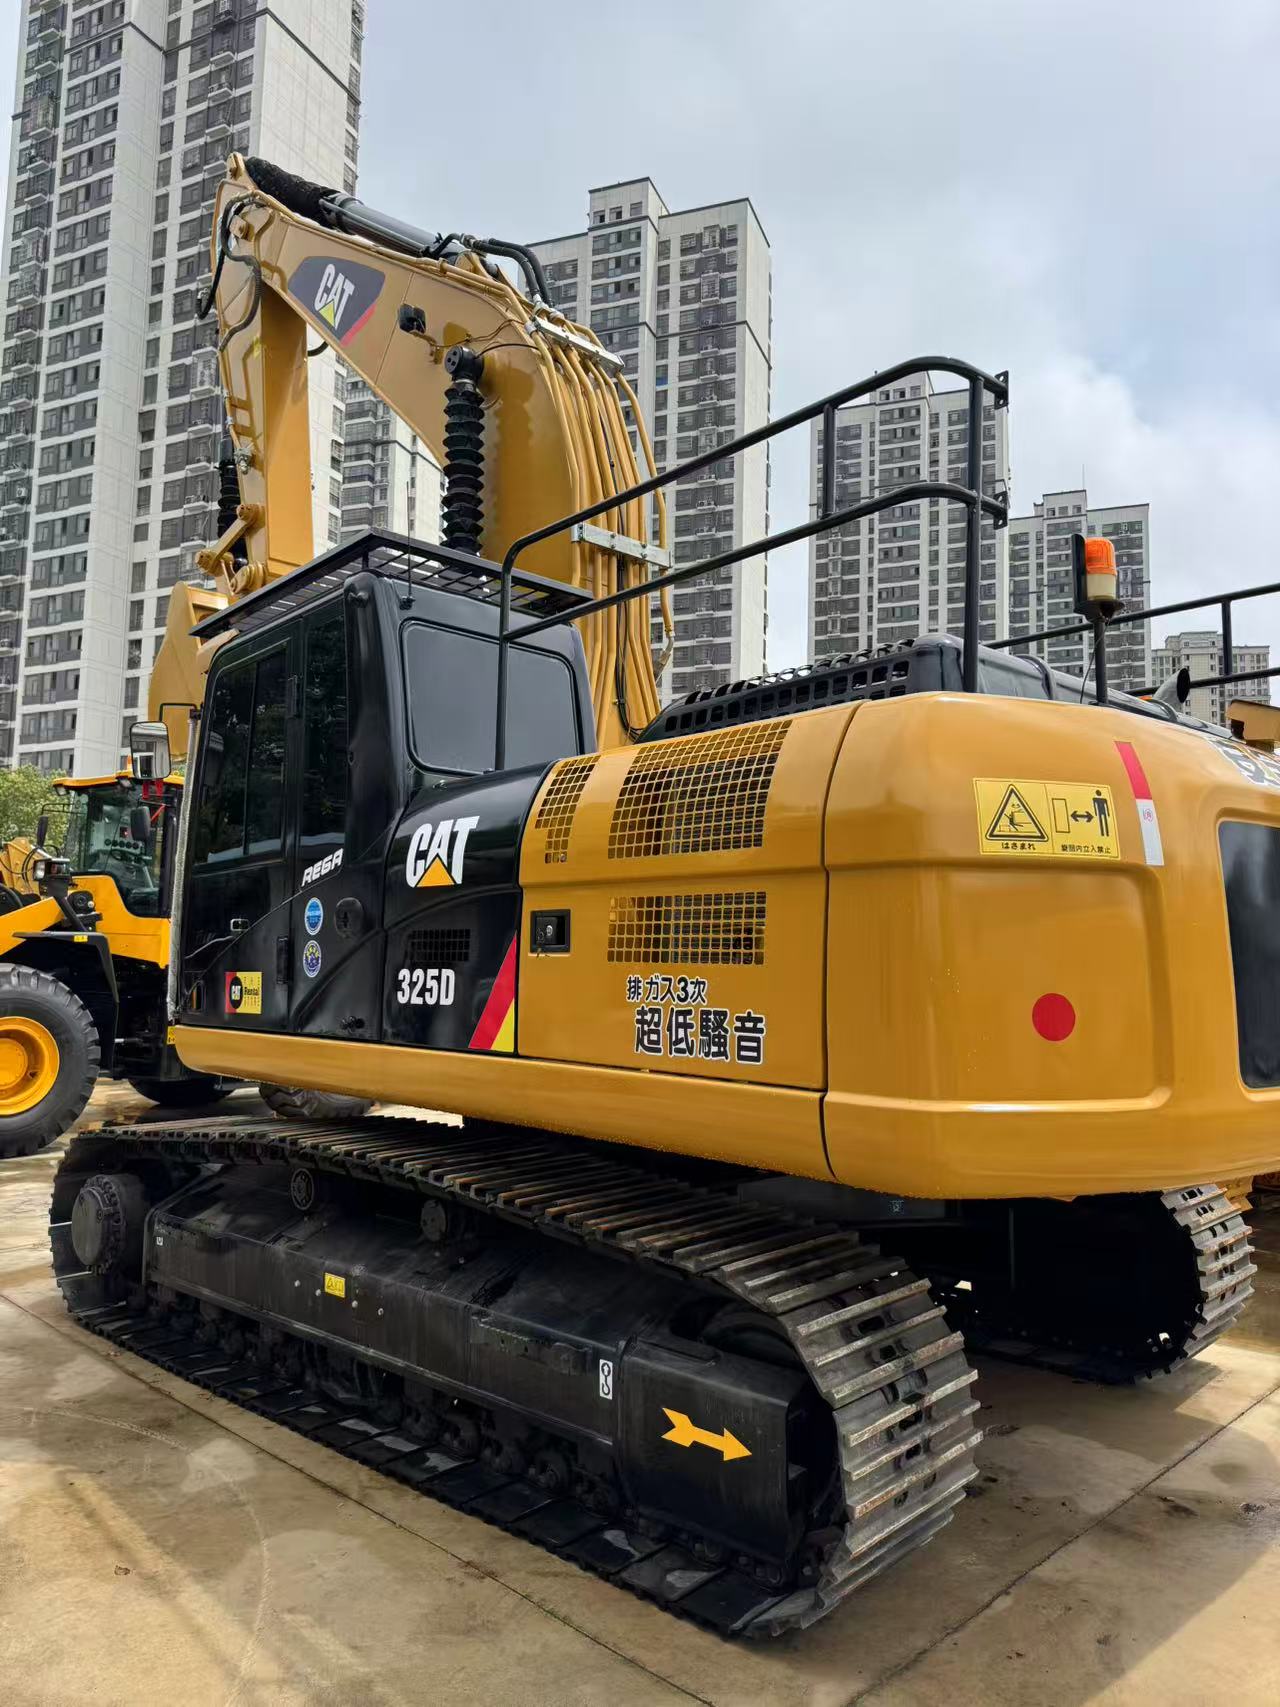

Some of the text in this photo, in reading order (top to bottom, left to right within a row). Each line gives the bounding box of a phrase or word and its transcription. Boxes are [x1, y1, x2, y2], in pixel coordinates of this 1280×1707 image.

[314, 263, 356, 331] CAT
[301, 847, 344, 887] REGA
[406, 815, 480, 888] CAT
[396, 968, 456, 1006] 325D
[626, 973, 708, 1005] 排ガス3次
[634, 1005, 766, 1064] 超低騒音
